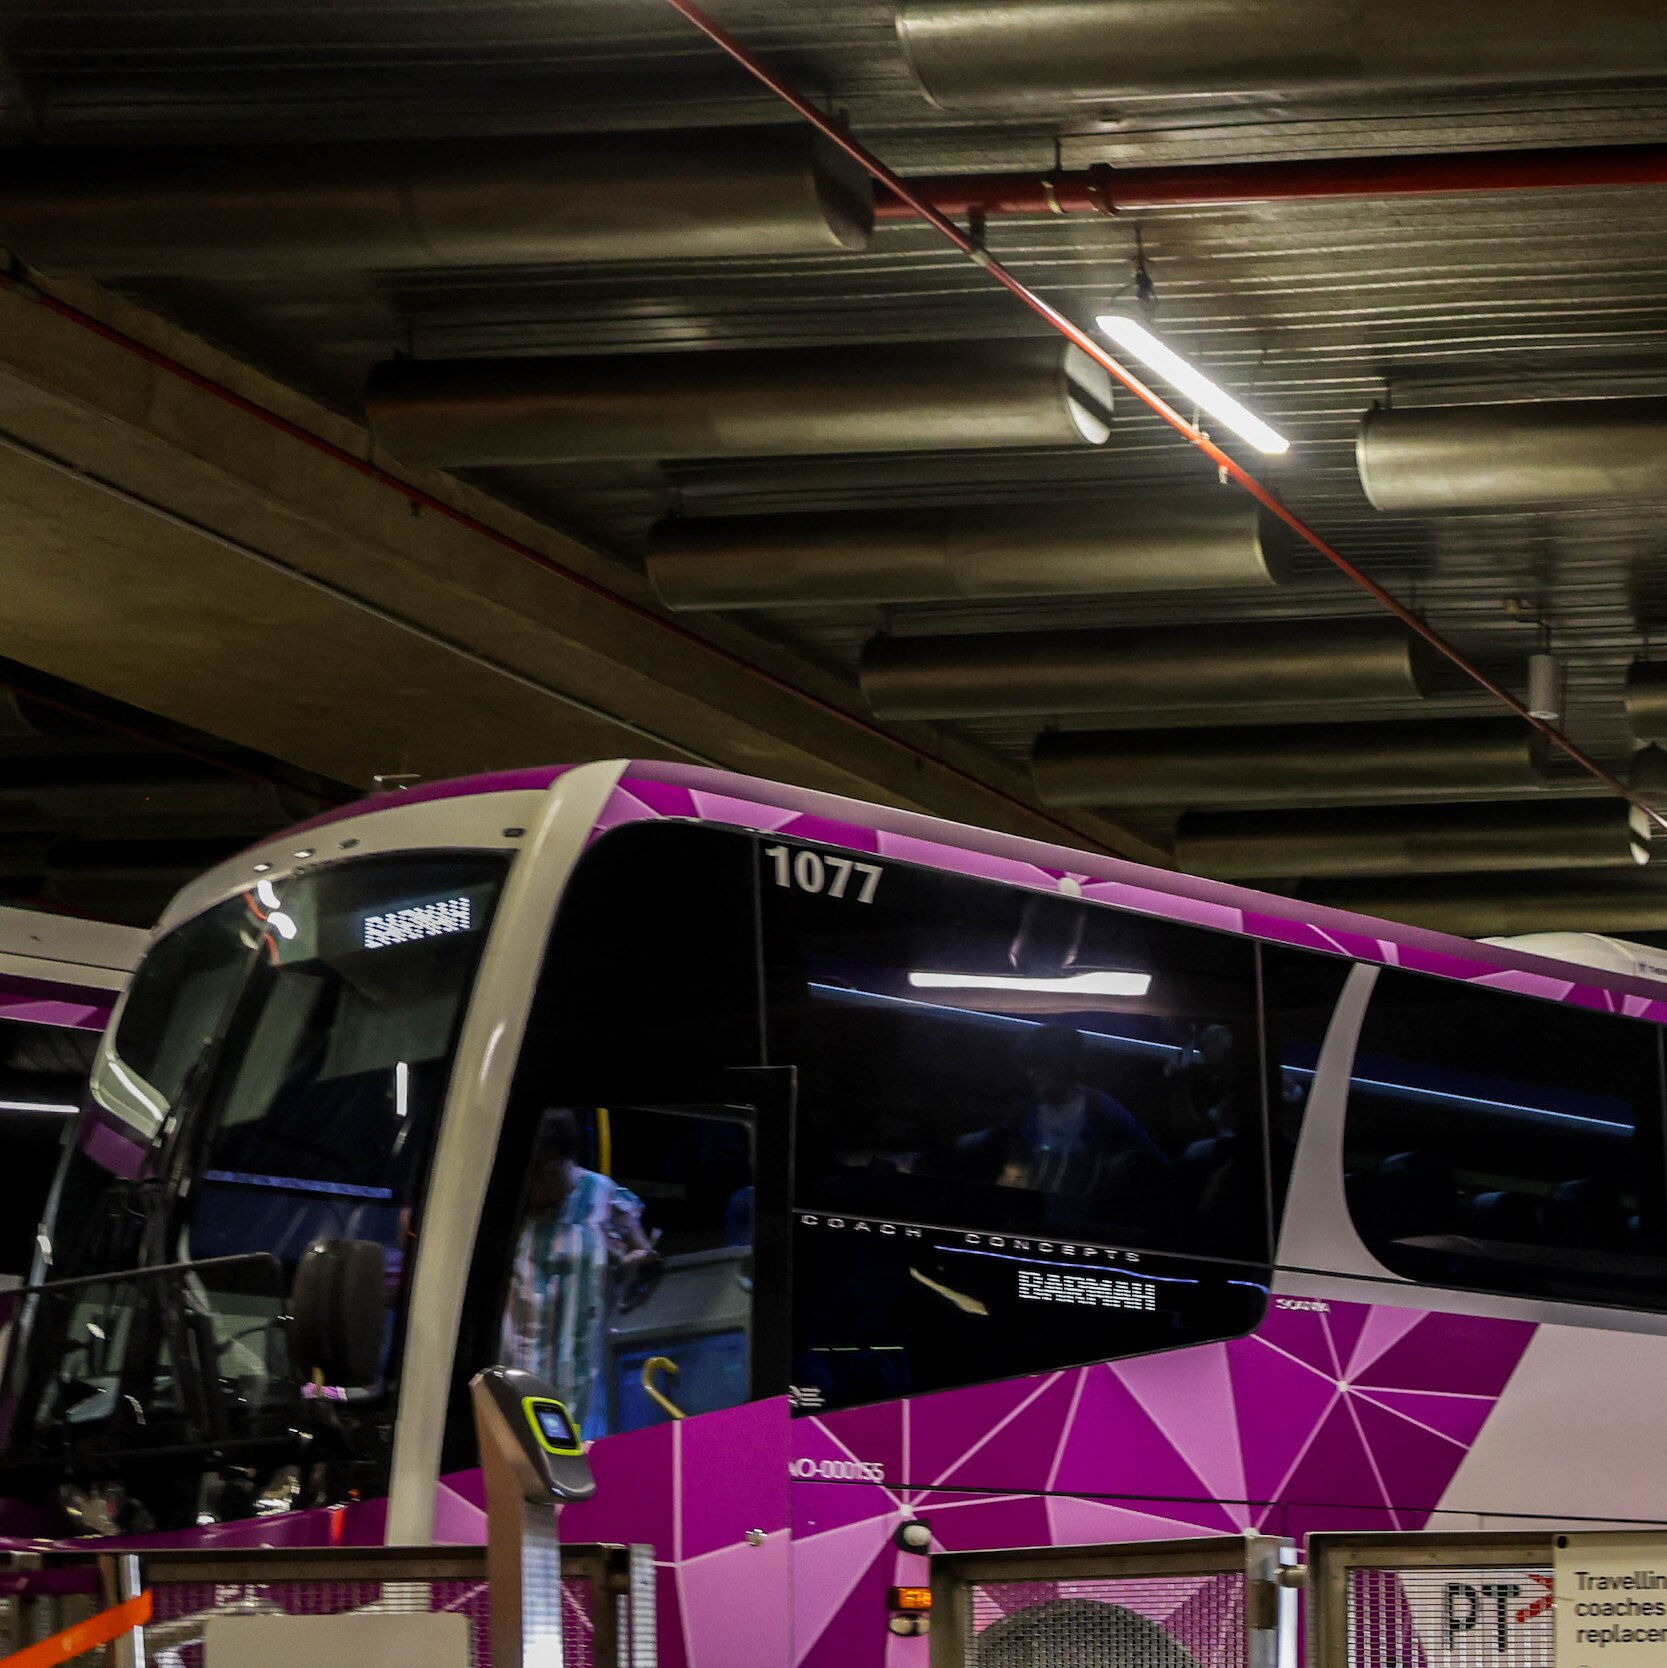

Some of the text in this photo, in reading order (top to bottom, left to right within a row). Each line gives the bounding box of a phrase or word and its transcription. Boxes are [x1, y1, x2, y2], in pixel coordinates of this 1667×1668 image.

[765, 845, 884, 904] 1077
[800, 1214, 1140, 1262] COACH CONCEPTS
[1018, 1270, 1156, 1311] BARMAH
[1575, 1598, 1666, 1617] coaches
